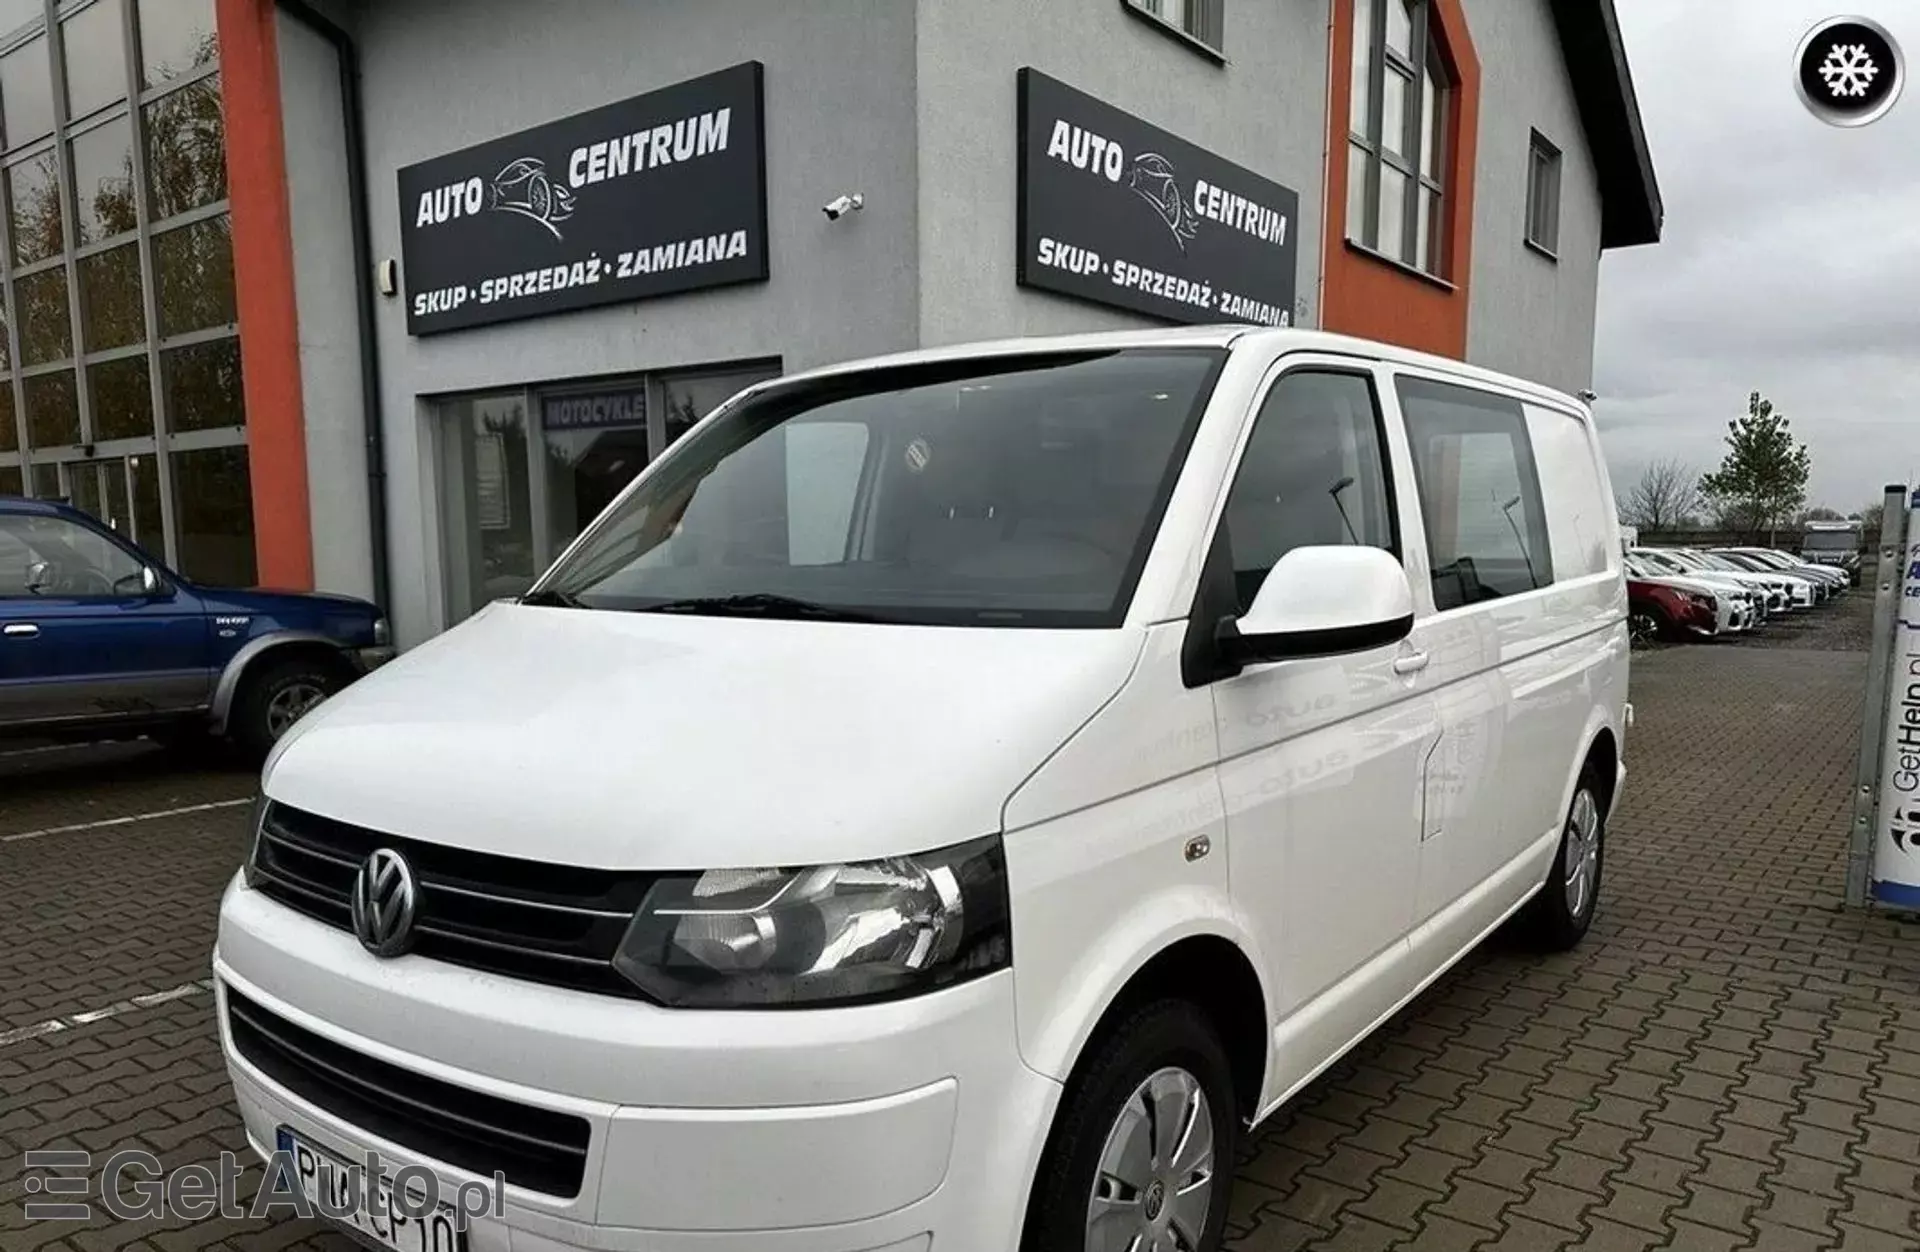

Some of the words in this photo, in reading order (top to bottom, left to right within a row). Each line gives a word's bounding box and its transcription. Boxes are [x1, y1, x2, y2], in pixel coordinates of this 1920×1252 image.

[416, 176, 483, 228] AUTO
[569, 108, 731, 189] CENTRUM
[1047, 119, 1124, 182] AUTO
[1194, 179, 1287, 246] CENTRUM
[413, 285, 466, 316] SKUP
[479, 251, 601, 304] SPRZEDAŻ
[616, 230, 747, 279] ZAMIANA
[1037, 238, 1100, 275] SKUP
[1112, 259, 1211, 308] SPRZEDAŻ
[1221, 292, 1290, 327] ZAMIANA
[546, 394, 645, 425] MOTOCYKLE
